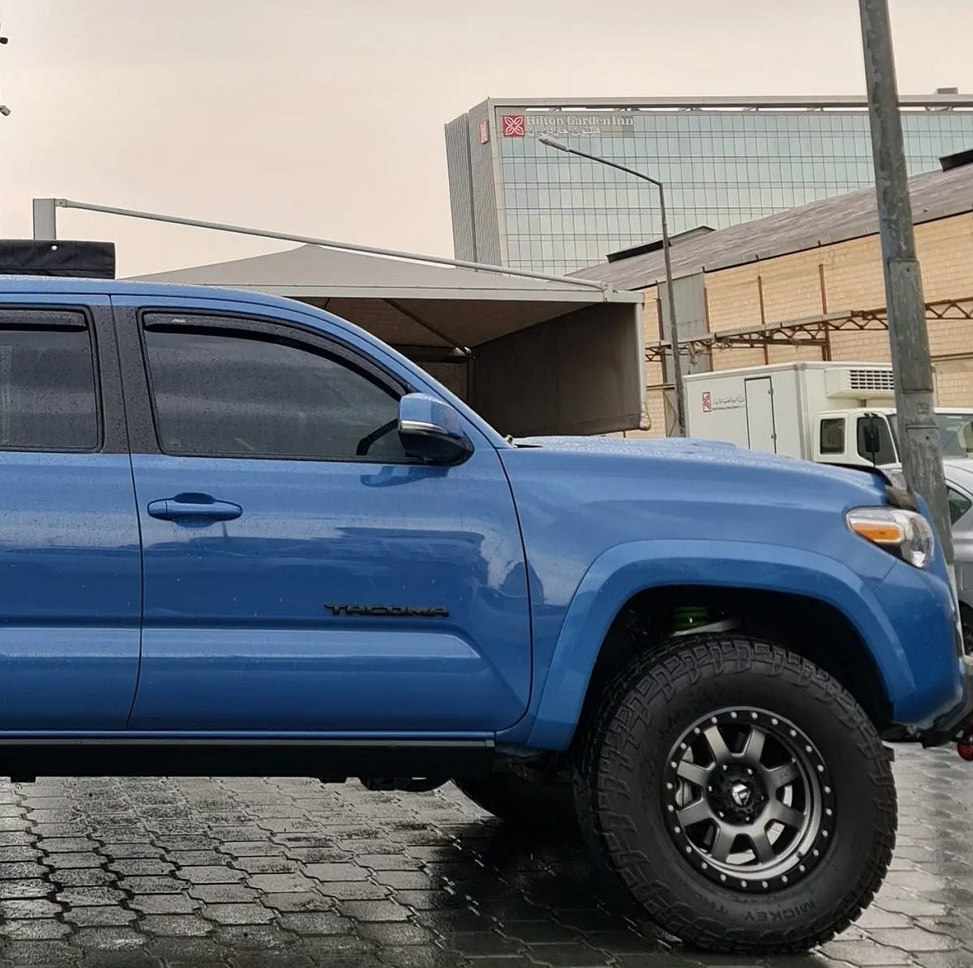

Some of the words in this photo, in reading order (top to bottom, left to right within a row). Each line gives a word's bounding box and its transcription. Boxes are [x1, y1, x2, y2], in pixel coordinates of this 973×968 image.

[527, 115, 564, 126] Hilton
[567, 115, 611, 126] Garden
[612, 115, 634, 126] Inn
[743, 899, 816, 922] MICKEY
